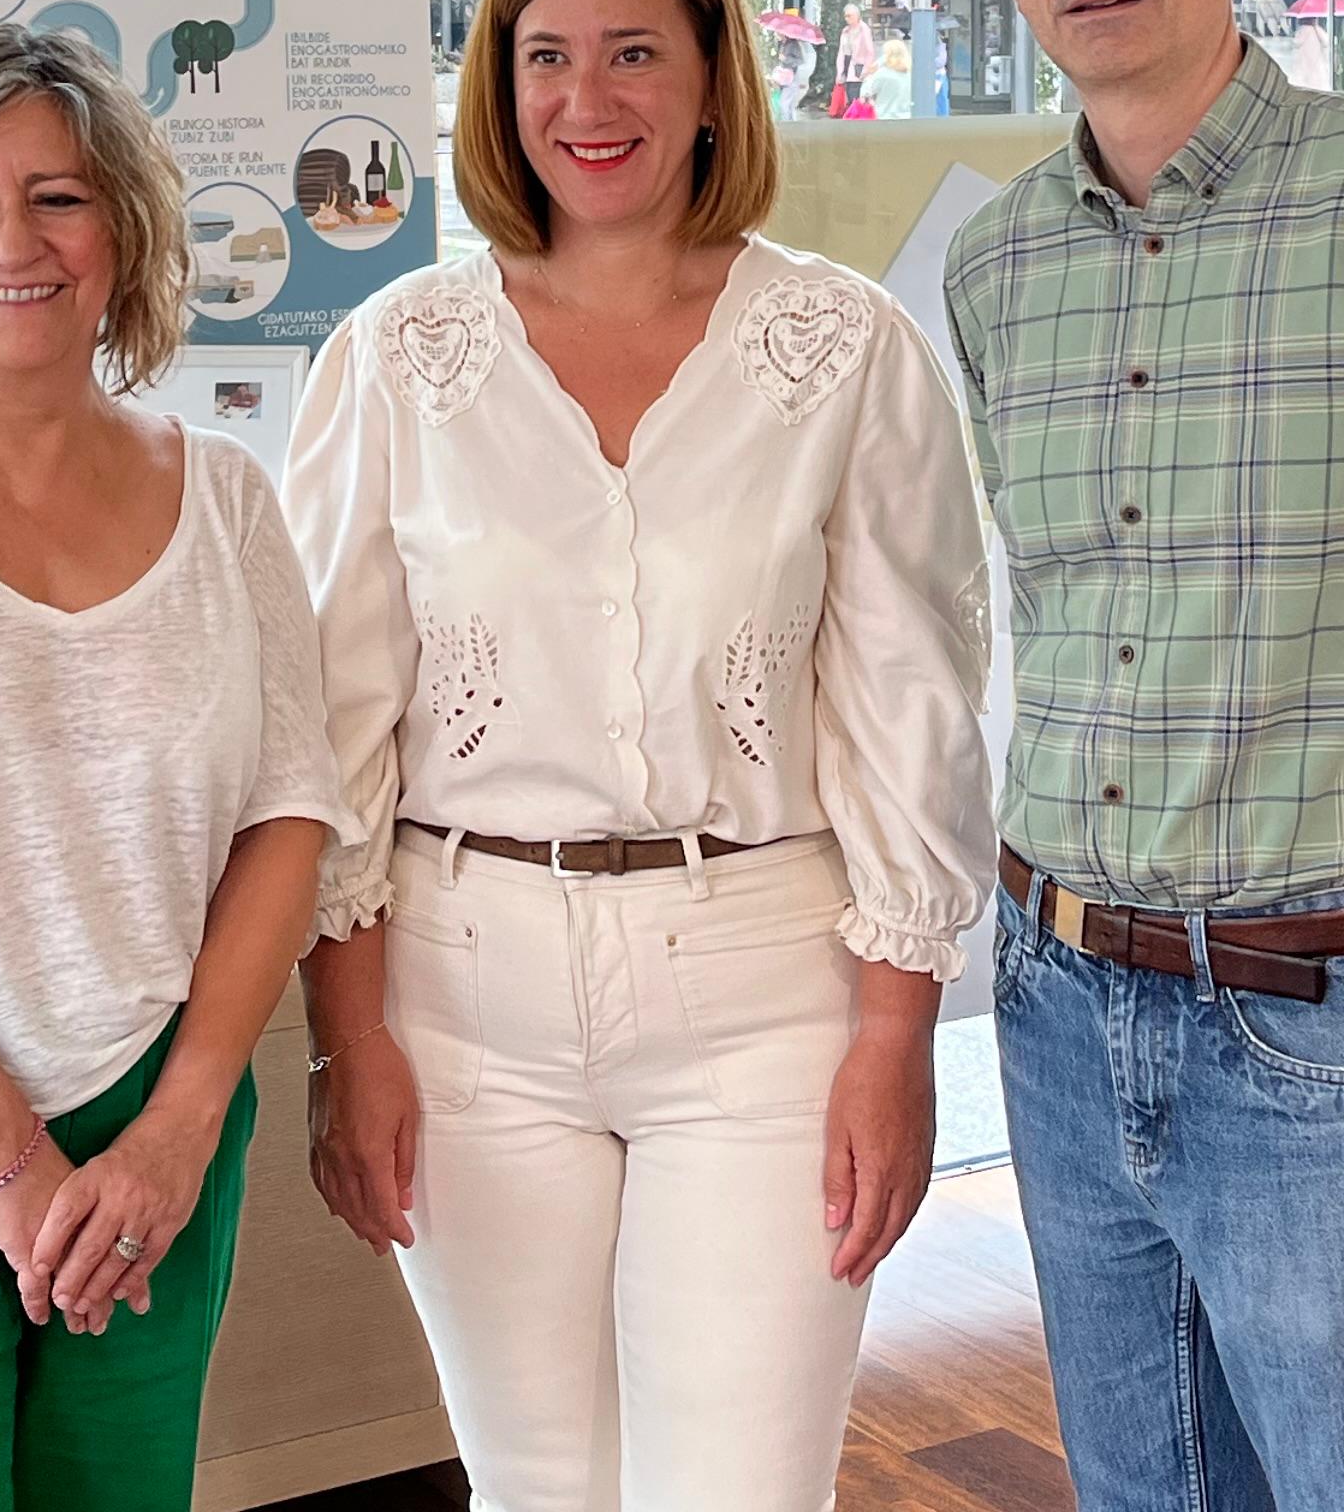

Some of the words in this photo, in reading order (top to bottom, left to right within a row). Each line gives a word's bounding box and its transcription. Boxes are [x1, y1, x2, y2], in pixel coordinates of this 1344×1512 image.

[290, 32, 331, 43] IBILBIDE
[291, 44, 407, 56] ENOGASTRONOMIKO
[291, 57, 308, 69] BAT
[291, 74, 307, 85] UN
[311, 73, 376, 85] RECORRIDO
[292, 84, 411, 98] ENOGASTRONÓMICO
[292, 99, 316, 111] POR
[319, 99, 343, 111] IRUN
[169, 118, 214, 131] IRUNGO
[217, 117, 265, 130] HISTORIA
[170, 131, 204, 144] ZUBIZ
[208, 131, 234, 143] ZUBI
[221, 152, 234, 164] DE
[239, 151, 264, 163] IRUN
[189, 165, 230, 178] PUENTE
[234, 165, 242, 176] A
[246, 163, 287, 176] PUENTE
[257, 309, 327, 326] GIDATUTAKO
[264, 323, 332, 338] EZAGUTZEN
